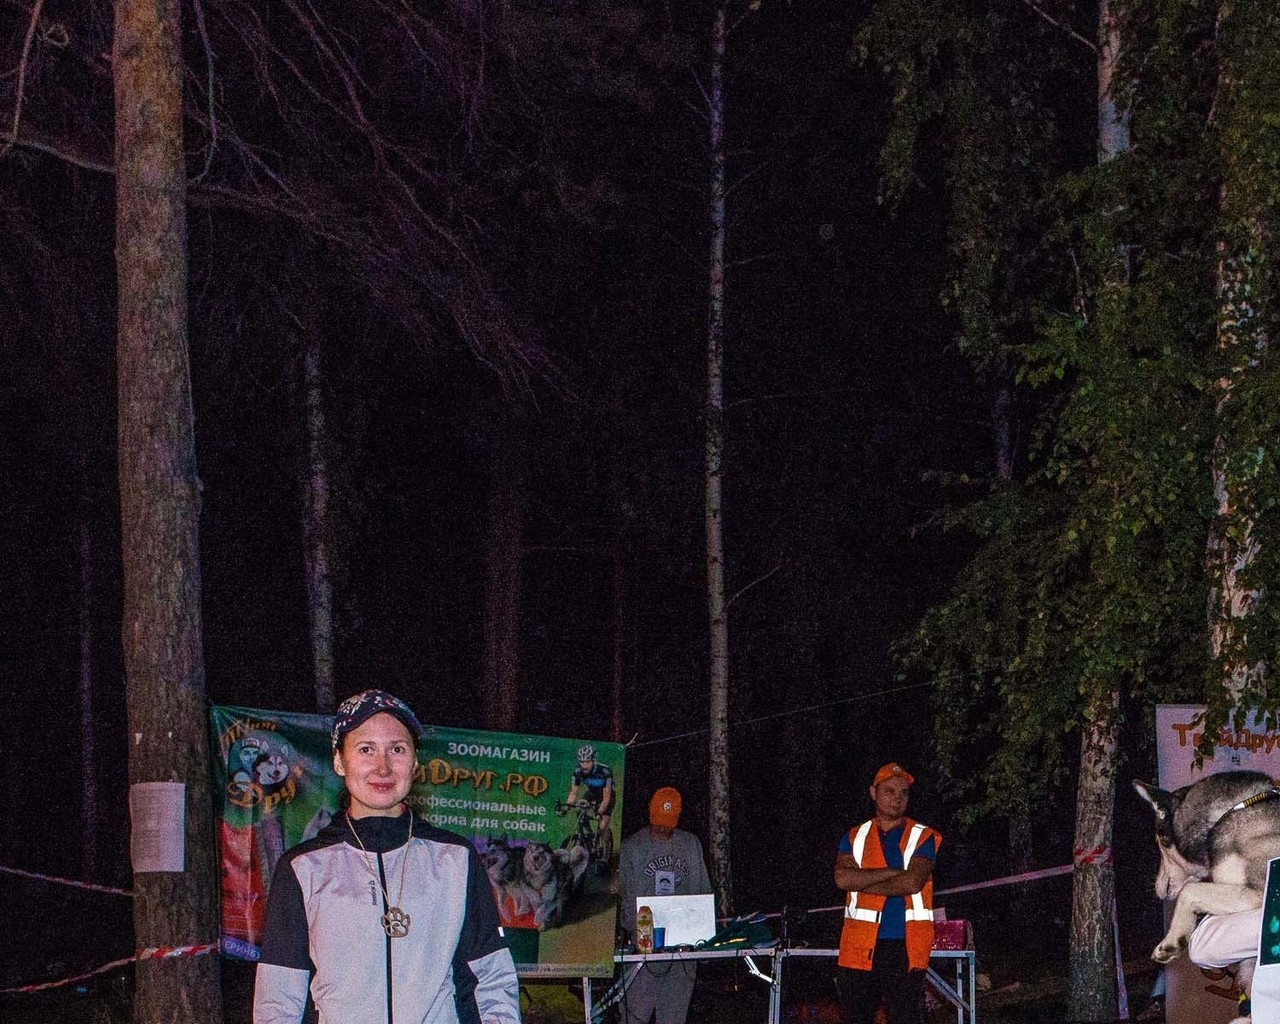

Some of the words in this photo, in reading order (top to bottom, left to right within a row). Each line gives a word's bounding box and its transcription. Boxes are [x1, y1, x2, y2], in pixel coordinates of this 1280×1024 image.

[447, 742, 551, 763] ЗООМАГАЗИН
[405, 793, 547, 816] офессиональные
[470, 817, 498, 829] для
[502, 817, 546, 832] собак
